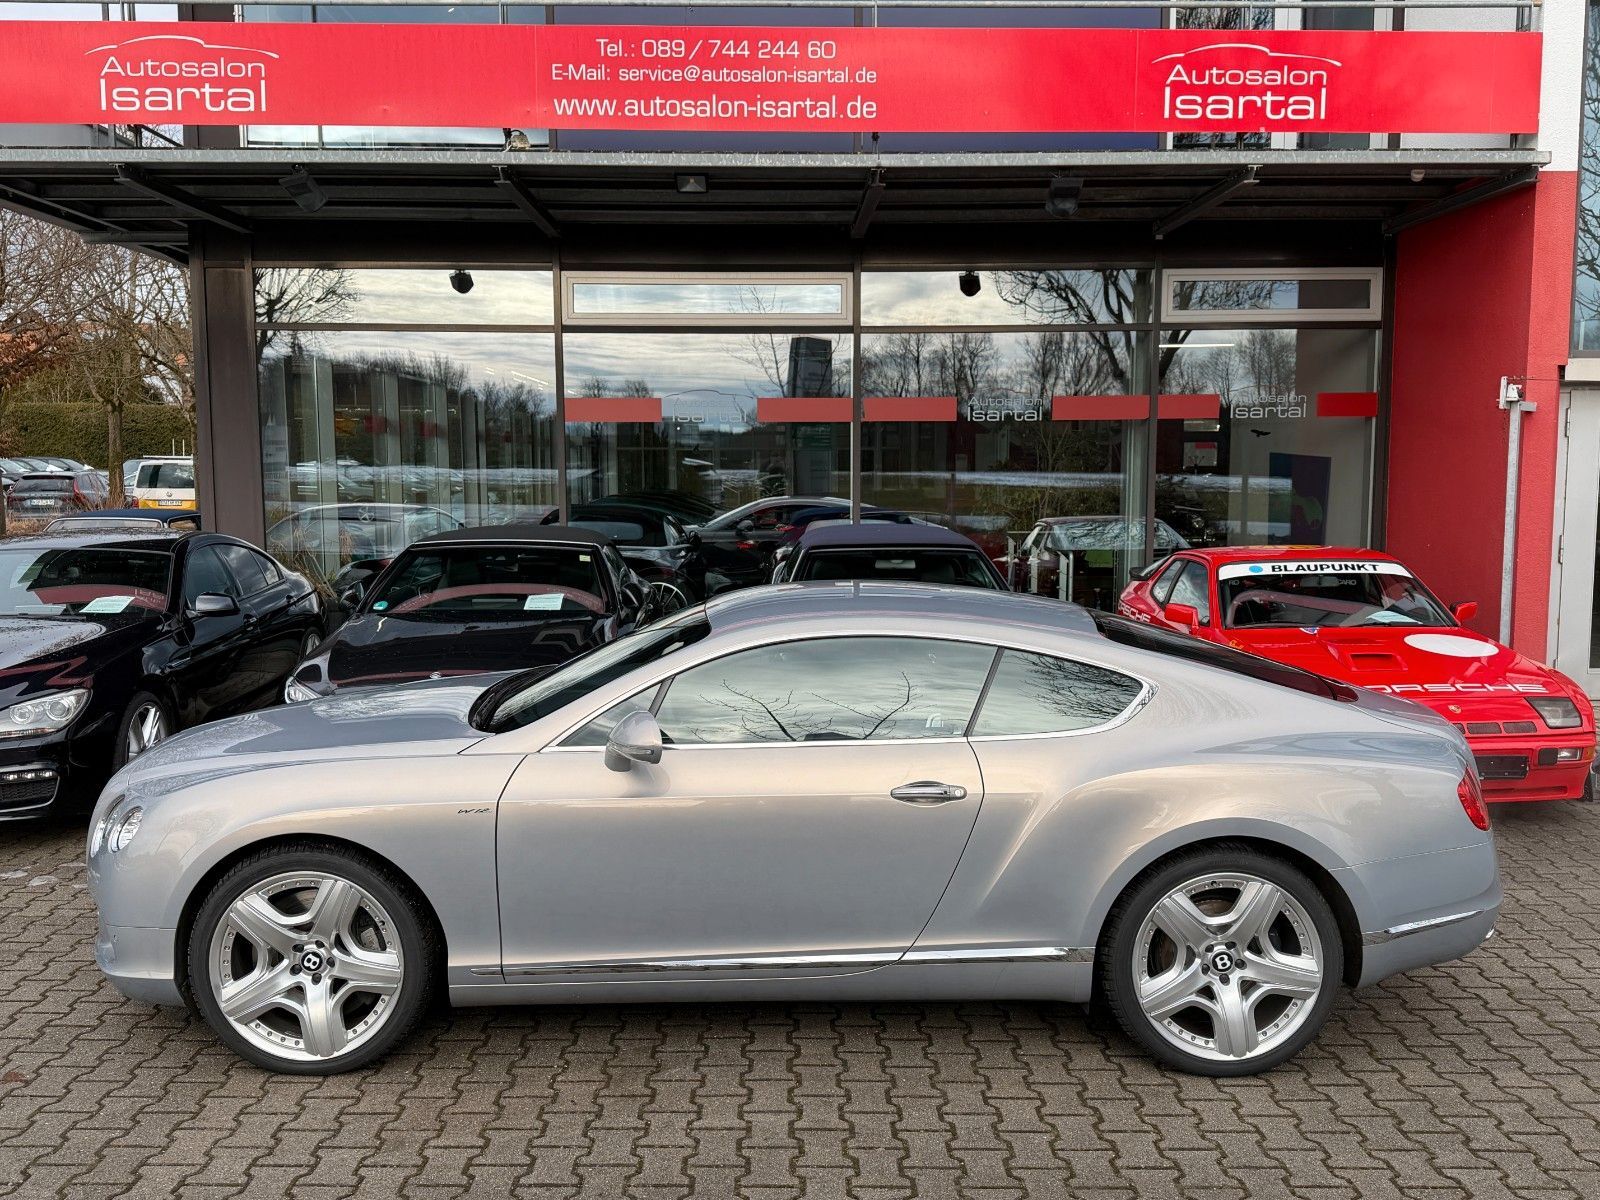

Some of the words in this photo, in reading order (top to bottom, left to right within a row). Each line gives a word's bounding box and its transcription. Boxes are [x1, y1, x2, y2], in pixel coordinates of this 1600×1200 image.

[595, 38, 635, 57] Tel.:
[641, 39, 685, 58] 089
[708, 39, 751, 58] 744
[758, 40, 801, 59] 244
[807, 40, 837, 59] 60
[100, 55, 266, 77] Autosalon
[551, 63, 611, 81] E-Mail:
[618, 64, 877, 84] service@autosalon-isartal.de
[1165, 64, 1328, 86] Autosalon
[99, 78, 267, 112] Isartal
[1163, 86, 1327, 120] Isartal
[553, 93, 877, 119] www.autosalon-isartal.de
[967, 406, 1043, 422] Isartal
[1230, 403, 1306, 419] Isartal
[1271, 563, 1380, 573] BLAUPUNKT
[1364, 683, 1549, 694] ORSCHE
